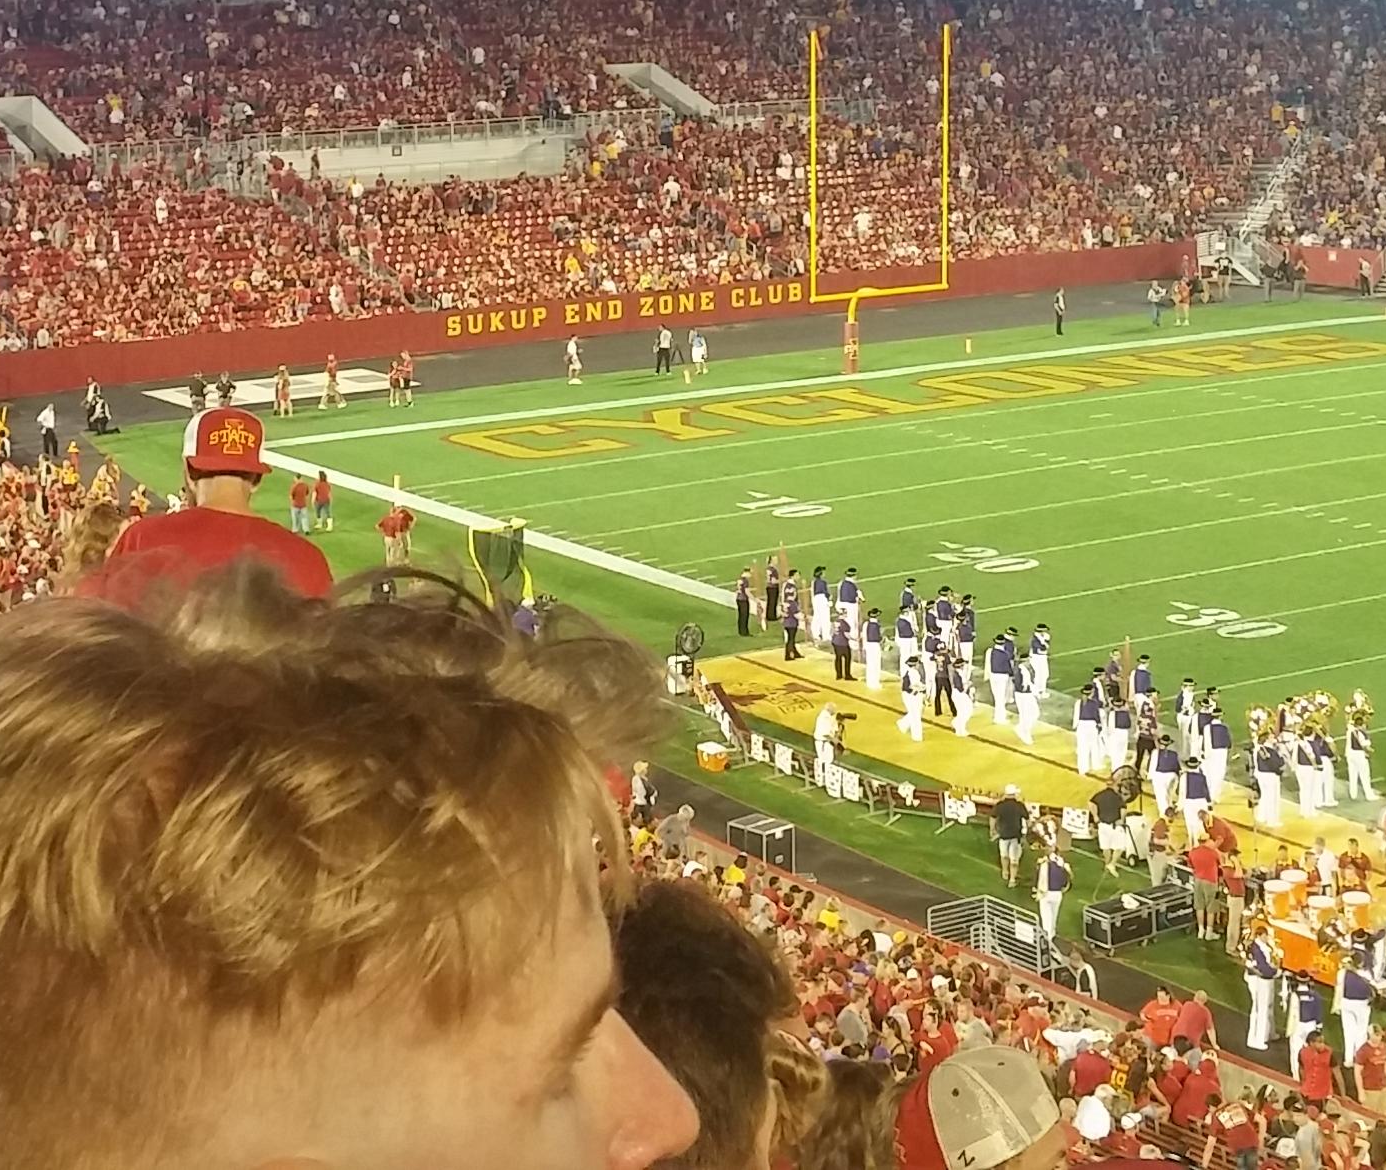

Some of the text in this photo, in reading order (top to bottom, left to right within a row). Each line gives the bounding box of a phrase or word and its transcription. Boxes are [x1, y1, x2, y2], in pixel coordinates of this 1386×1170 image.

[447, 282, 804, 337] SUKUP END ZONE CLUB
[209, 429, 256, 448] STATE
[735, 496, 833, 518] 10
[928, 546, 1040, 573] 20
[1166, 607, 1288, 639] 30
